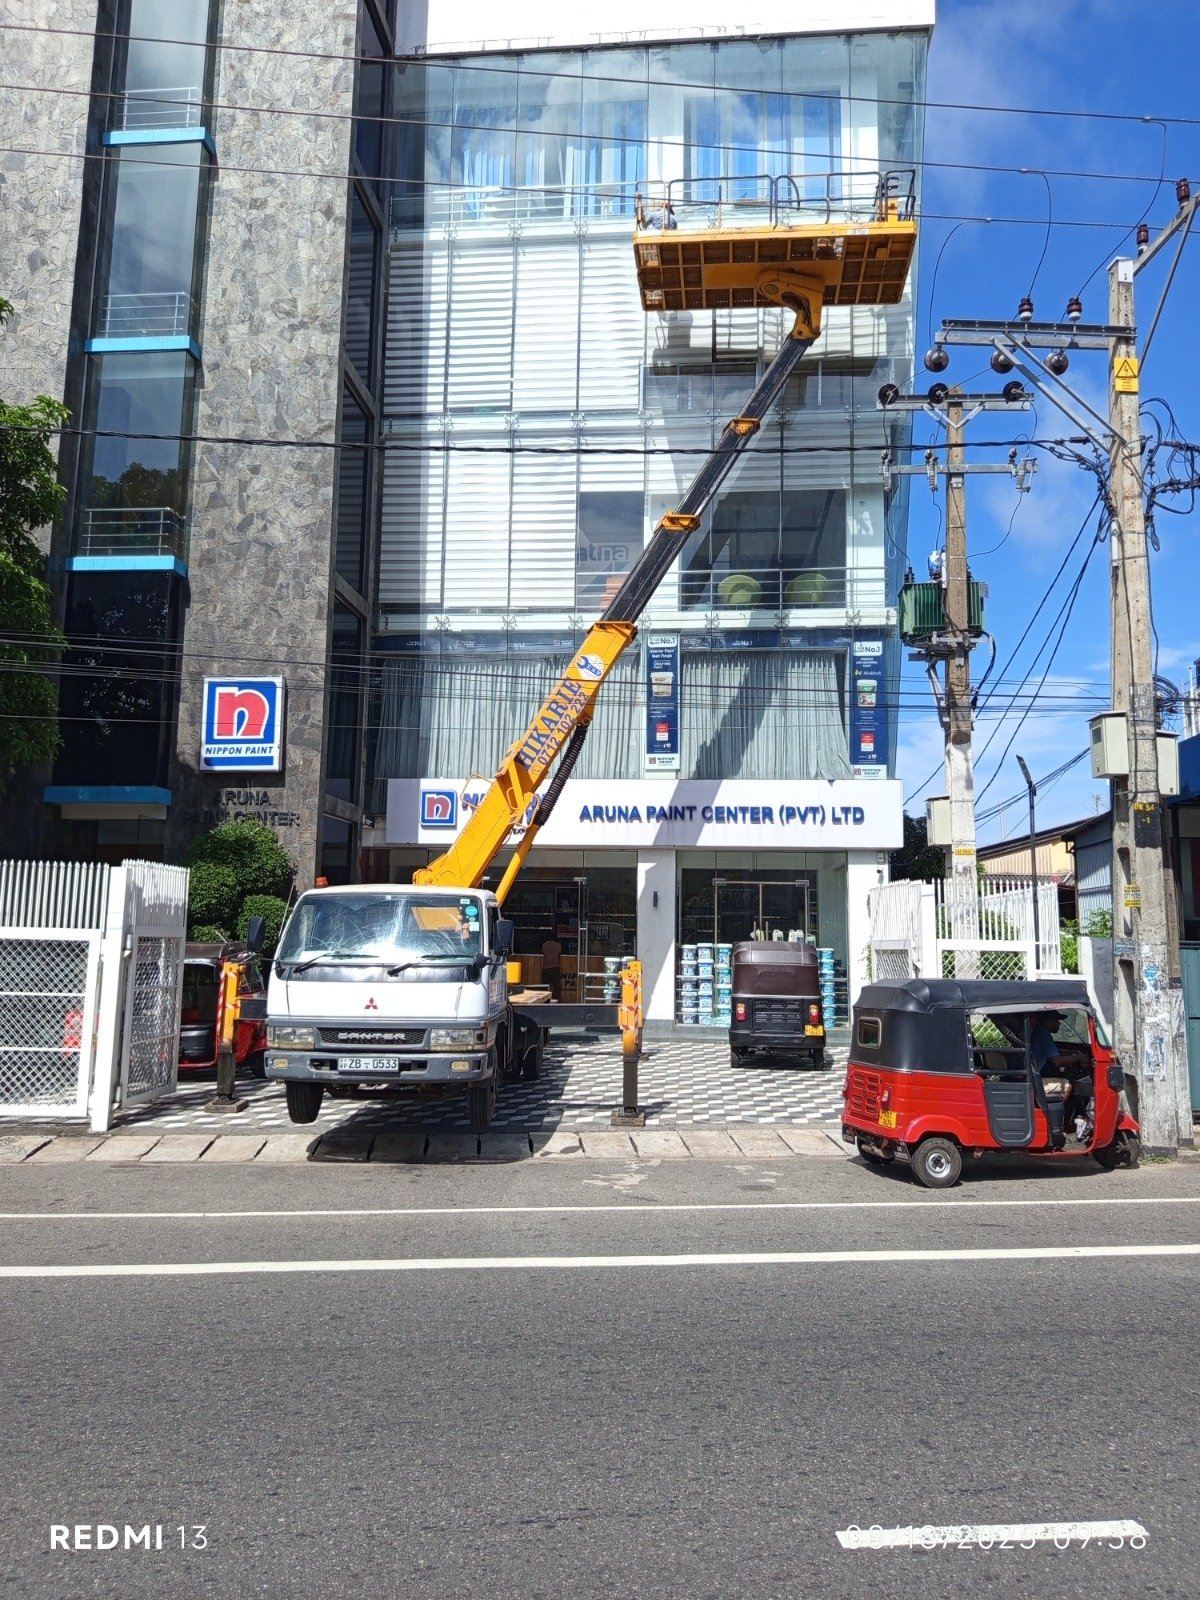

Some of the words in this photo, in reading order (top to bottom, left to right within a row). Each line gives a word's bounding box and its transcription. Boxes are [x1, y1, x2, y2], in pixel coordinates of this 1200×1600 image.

[514, 676, 582, 770] HIKARIE
[538, 737, 560, 766] 0712
[557, 714, 575, 736] 102
[571, 692, 589, 714] 222
[205, 746, 242, 755] NIPPON
[245, 746, 274, 755] PAINT
[213, 790, 272, 806] ARUNA
[234, 811, 301, 827] CENTER
[579, 805, 643, 823] ARUNA
[646, 805, 697, 823] PAINT
[701, 805, 774, 824] CENTER
[779, 804, 826, 826] (PVT)
[831, 805, 865, 825] LTD
[338, 1032, 407, 1041] CANTER
[348, 1059, 362, 1069] ZB
[372, 1059, 398, 1069] 0533
